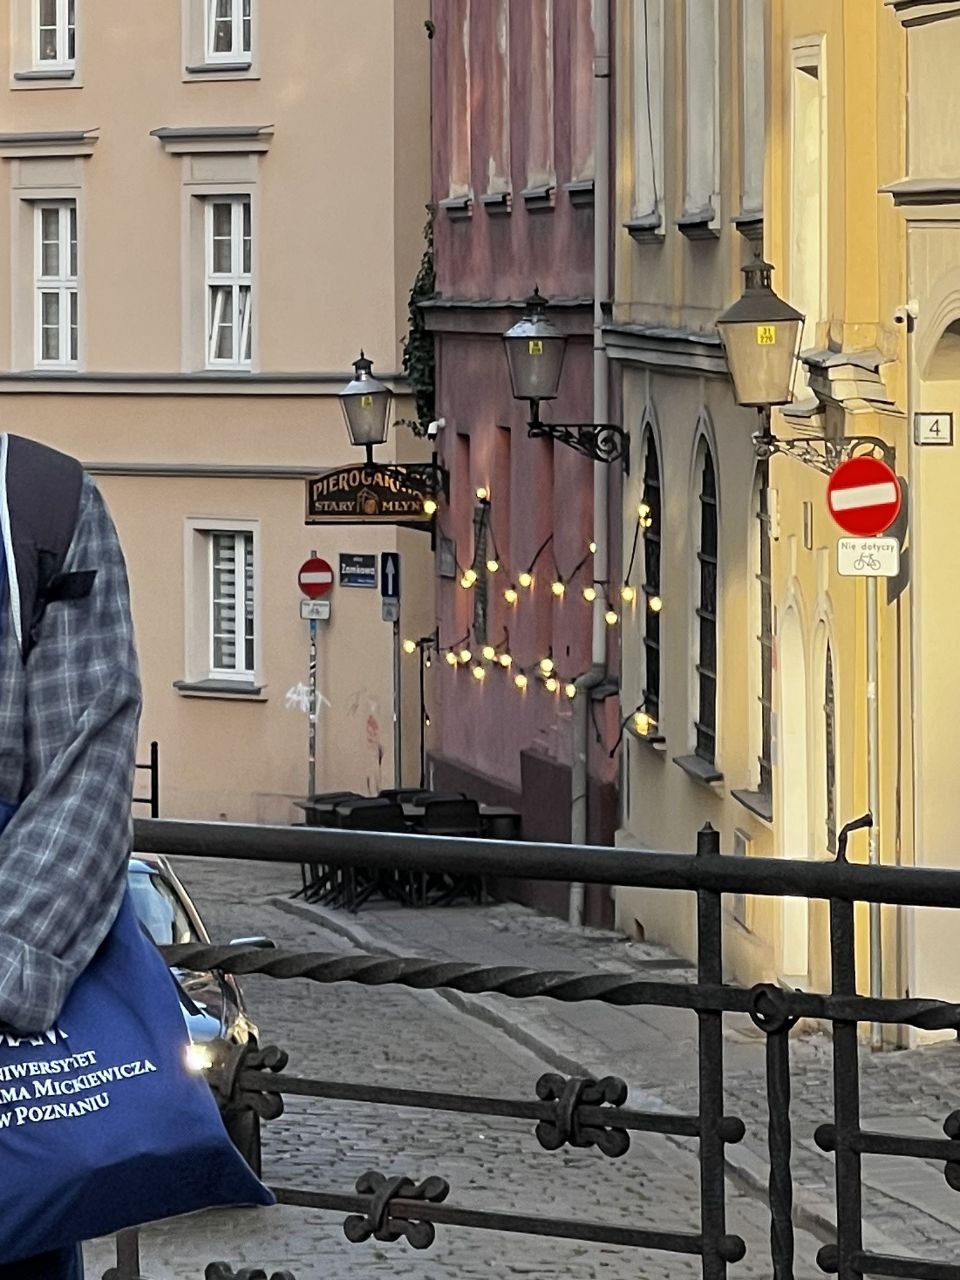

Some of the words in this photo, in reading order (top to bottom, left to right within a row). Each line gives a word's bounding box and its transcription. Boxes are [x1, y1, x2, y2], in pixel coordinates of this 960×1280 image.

[929, 419, 941, 436] 4
[313, 469, 425, 501] PIEROGAR
[315, 501, 355, 511] STARY
[841, 542, 857, 551] Nie
[860, 541, 895, 552] dotyczy
[32, 1059, 157, 1098] MICKIEWICZA
[15, 1092, 110, 1126] POZNANIU
